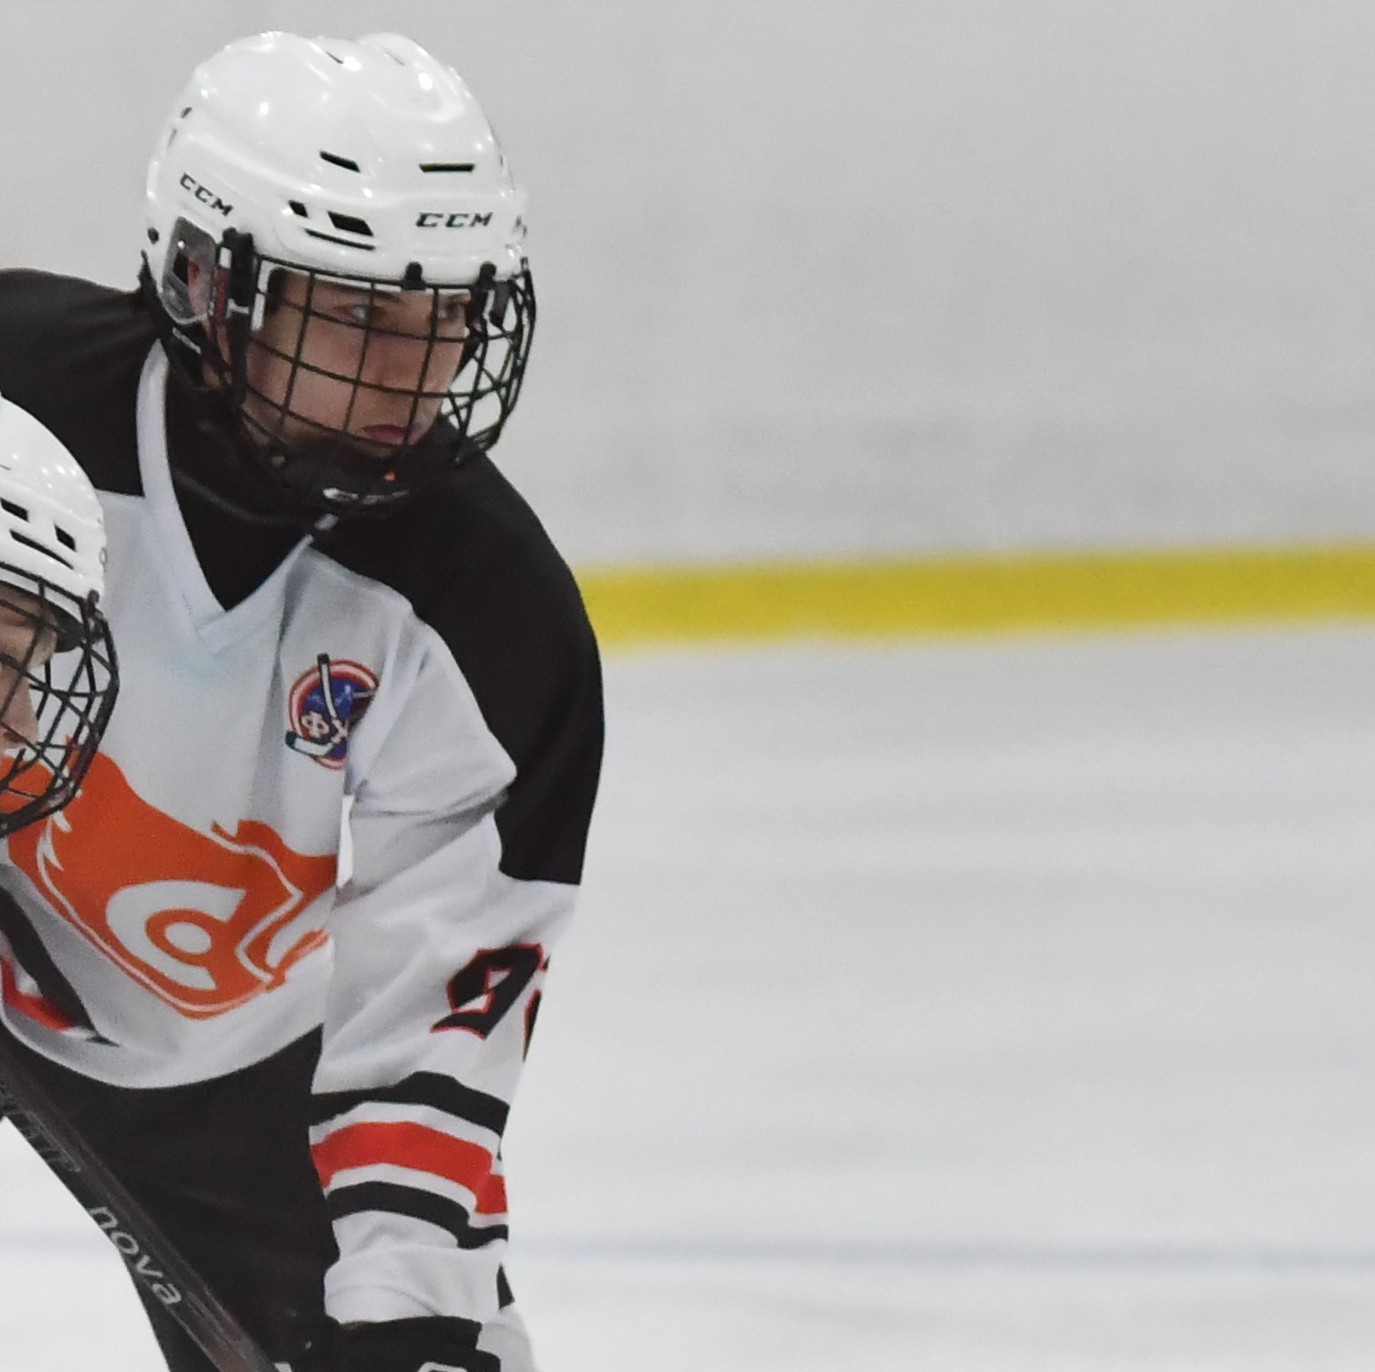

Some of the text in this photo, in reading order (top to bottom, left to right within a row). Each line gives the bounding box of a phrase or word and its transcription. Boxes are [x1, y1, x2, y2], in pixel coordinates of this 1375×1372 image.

[179, 172, 233, 216] CCM
[415, 211, 494, 228] CCM
[429, 941, 550, 1062] 9
[88, 1206, 182, 1305] nova
